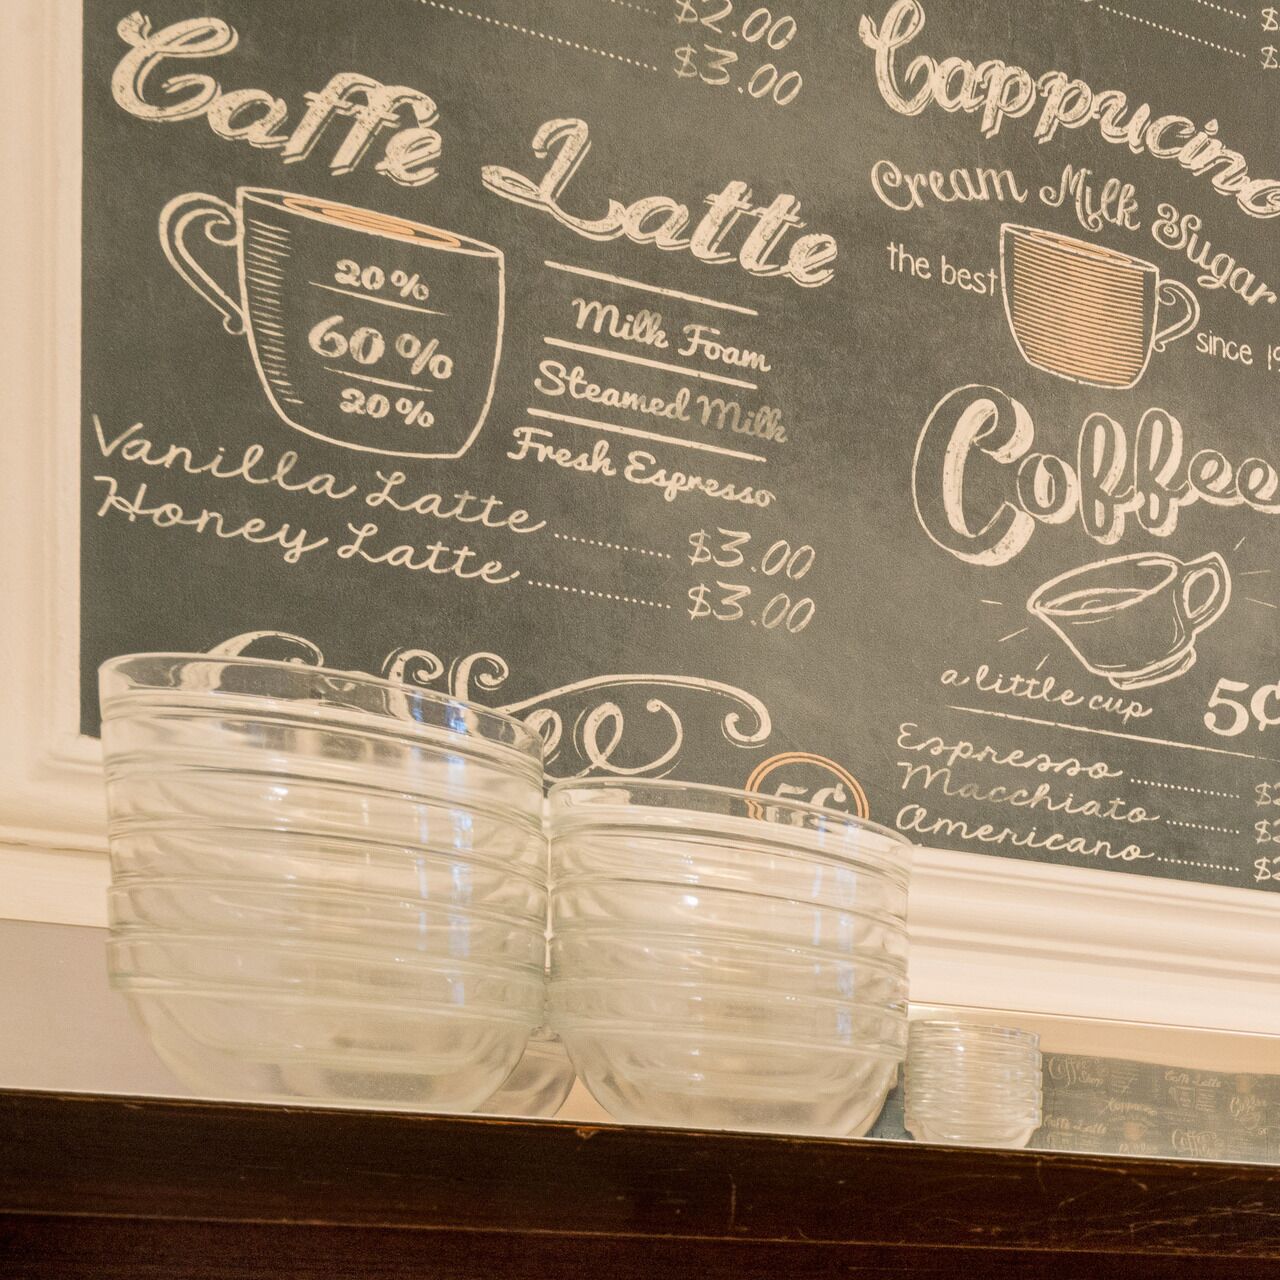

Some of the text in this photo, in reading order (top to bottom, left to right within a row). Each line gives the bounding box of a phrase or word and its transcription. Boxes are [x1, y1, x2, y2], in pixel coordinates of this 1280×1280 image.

[674, 43, 803, 106] $3.00
[481, 118, 838, 288] Latte
[870, 159, 1278, 306] Cream Milk Sugar
[334, 258, 430, 302] 20%
[886, 241, 1000, 296] the best
[308, 314, 454, 381] 60%
[571, 297, 772, 373] Milk Foam
[1196, 330, 1253, 366] since
[339, 386, 435, 429] 20%
[534, 361, 789, 445] Steamed Milk
[91, 412, 816, 580] Vanilla Latte $3.00
[507, 425, 777, 509] Fresh Espresso
[94, 475, 816, 634] Honey Latte $3.00
[975, 664, 1086, 709] little
[1087, 694, 1154, 725] cup
[896, 723, 1123, 781] Espresso
[896, 762, 1161, 825] Macchiato
[896, 804, 1158, 863] Americano
